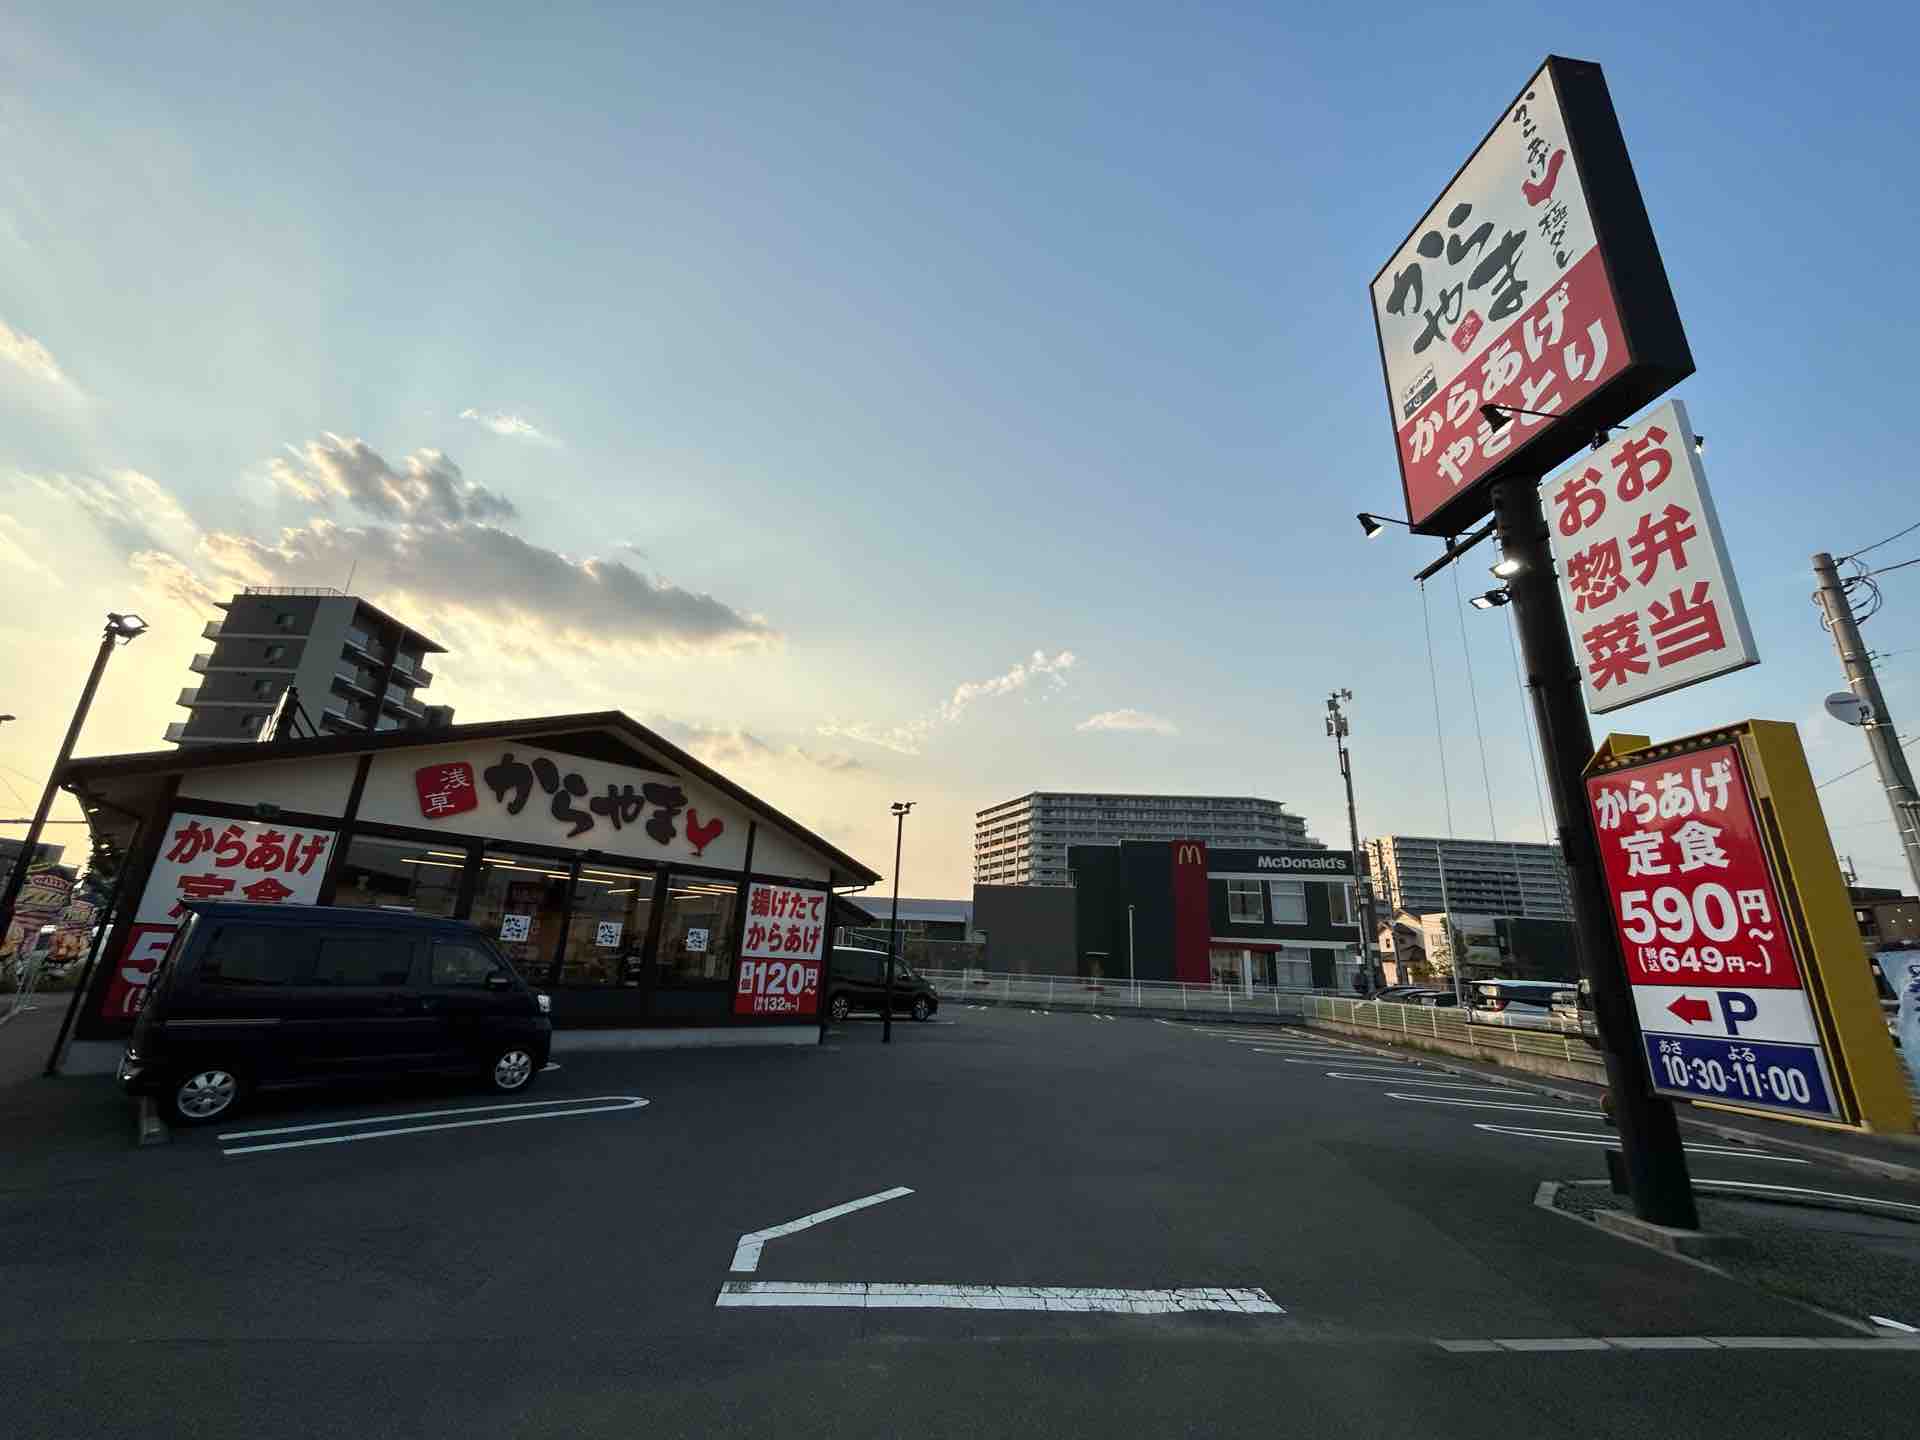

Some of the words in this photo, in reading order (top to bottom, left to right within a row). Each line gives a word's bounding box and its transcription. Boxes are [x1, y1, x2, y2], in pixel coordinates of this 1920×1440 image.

[1386, 203, 1528, 354] からやま
[1408, 282, 1570, 463] からあげ
[1437, 318, 1609, 486] やきとり
[1610, 426, 1726, 668] お弁当
[1554, 467, 1650, 690] お惣菜
[425, 767, 471, 814] 浅草
[484, 753, 689, 846] からやま
[1596, 758, 1733, 830] からあげ
[165, 820, 330, 876] からあげ
[1258, 856, 1346, 870] McDonald's
[1619, 820, 1730, 878] 定食
[751, 888, 824, 921] 揚げたて
[746, 921, 821, 955] からあげ
[1716, 991, 1758, 1035] P
[1658, 1038, 1683, 1055] あさ
[1727, 1046, 1758, 1063] よる
